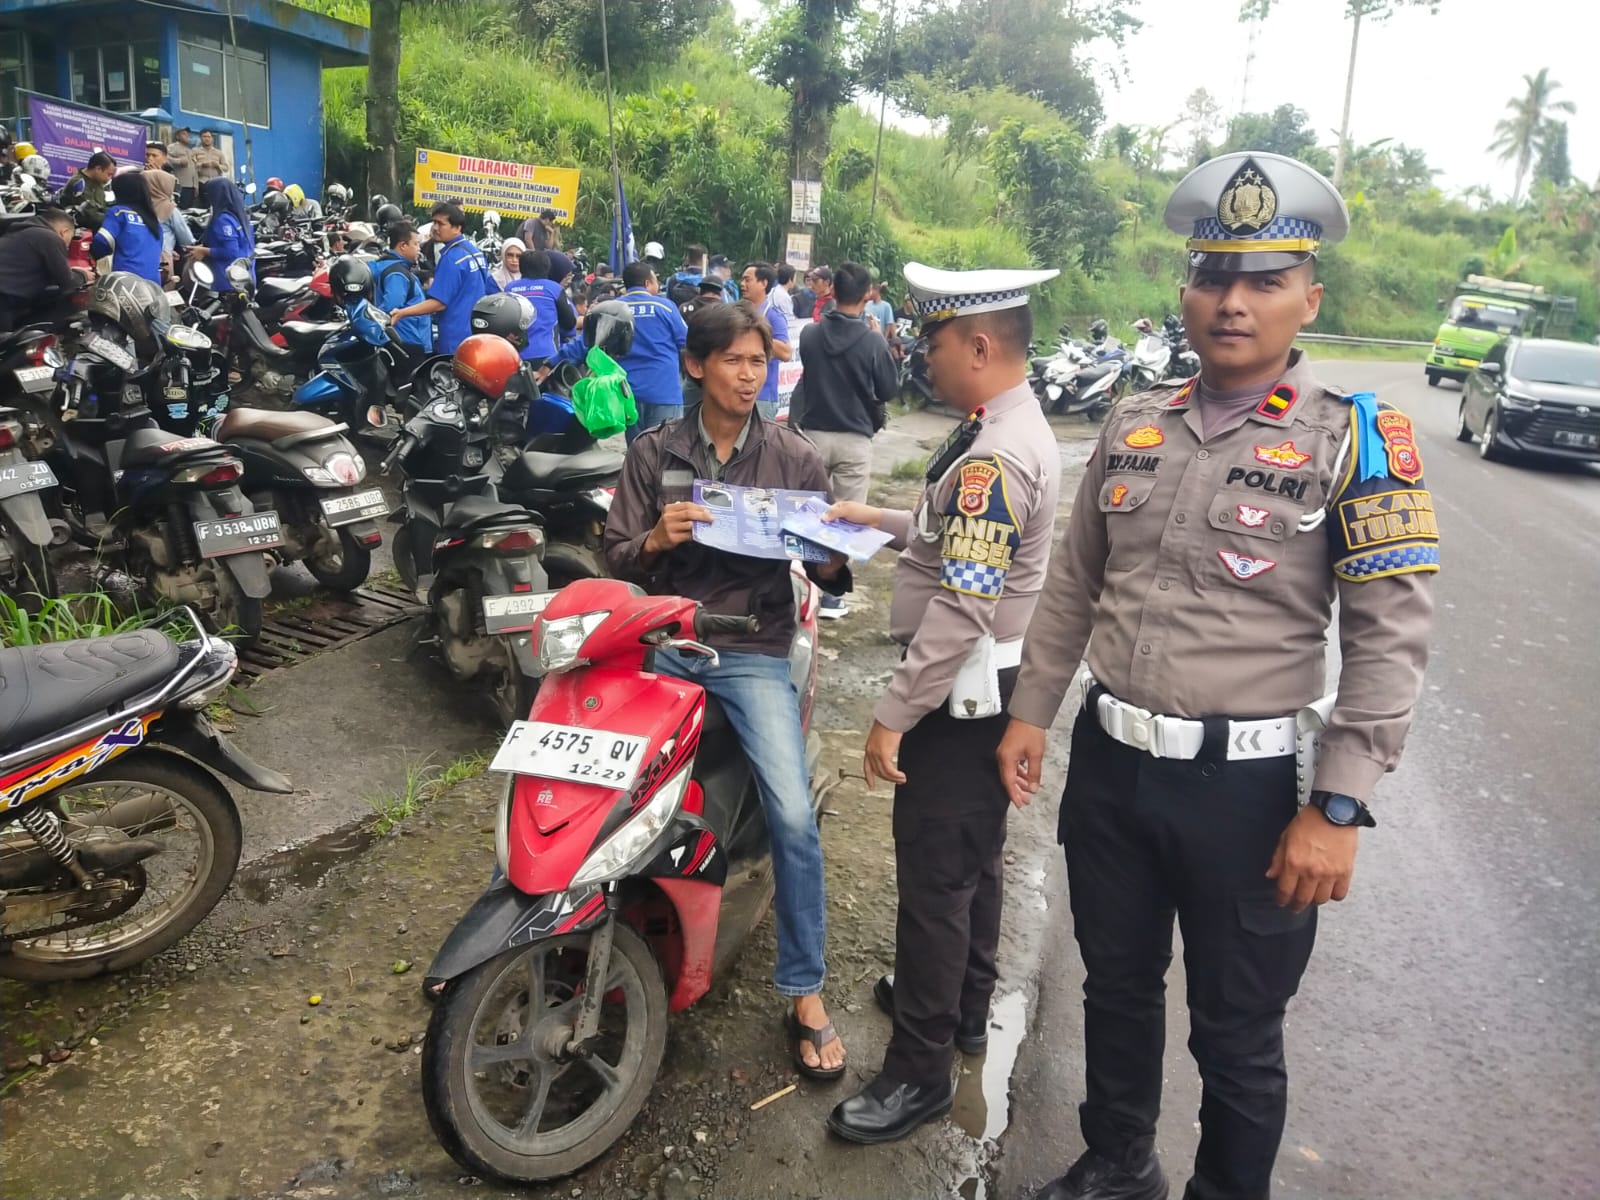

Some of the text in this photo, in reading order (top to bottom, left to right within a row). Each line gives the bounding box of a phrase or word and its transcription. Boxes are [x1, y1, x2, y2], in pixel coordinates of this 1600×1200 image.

[459, 157, 517, 177] DILARANG
[431, 171, 478, 184] MENGELUARKAN
[488, 178, 521, 189] MEMINDAH
[523, 182, 560, 194] TANGANKAN
[463, 186, 481, 195] ASSET
[483, 188, 523, 201] PERUSAHAAN
[478, 198, 517, 211] KOMPENSASI
[519, 203, 531, 212] PHK
[1226, 466, 1309, 500] POLRI
[200, 516, 277, 540] F 3538 UBN
[488, 602, 496, 616] F
[508, 727, 640, 762] F 4575 QV
